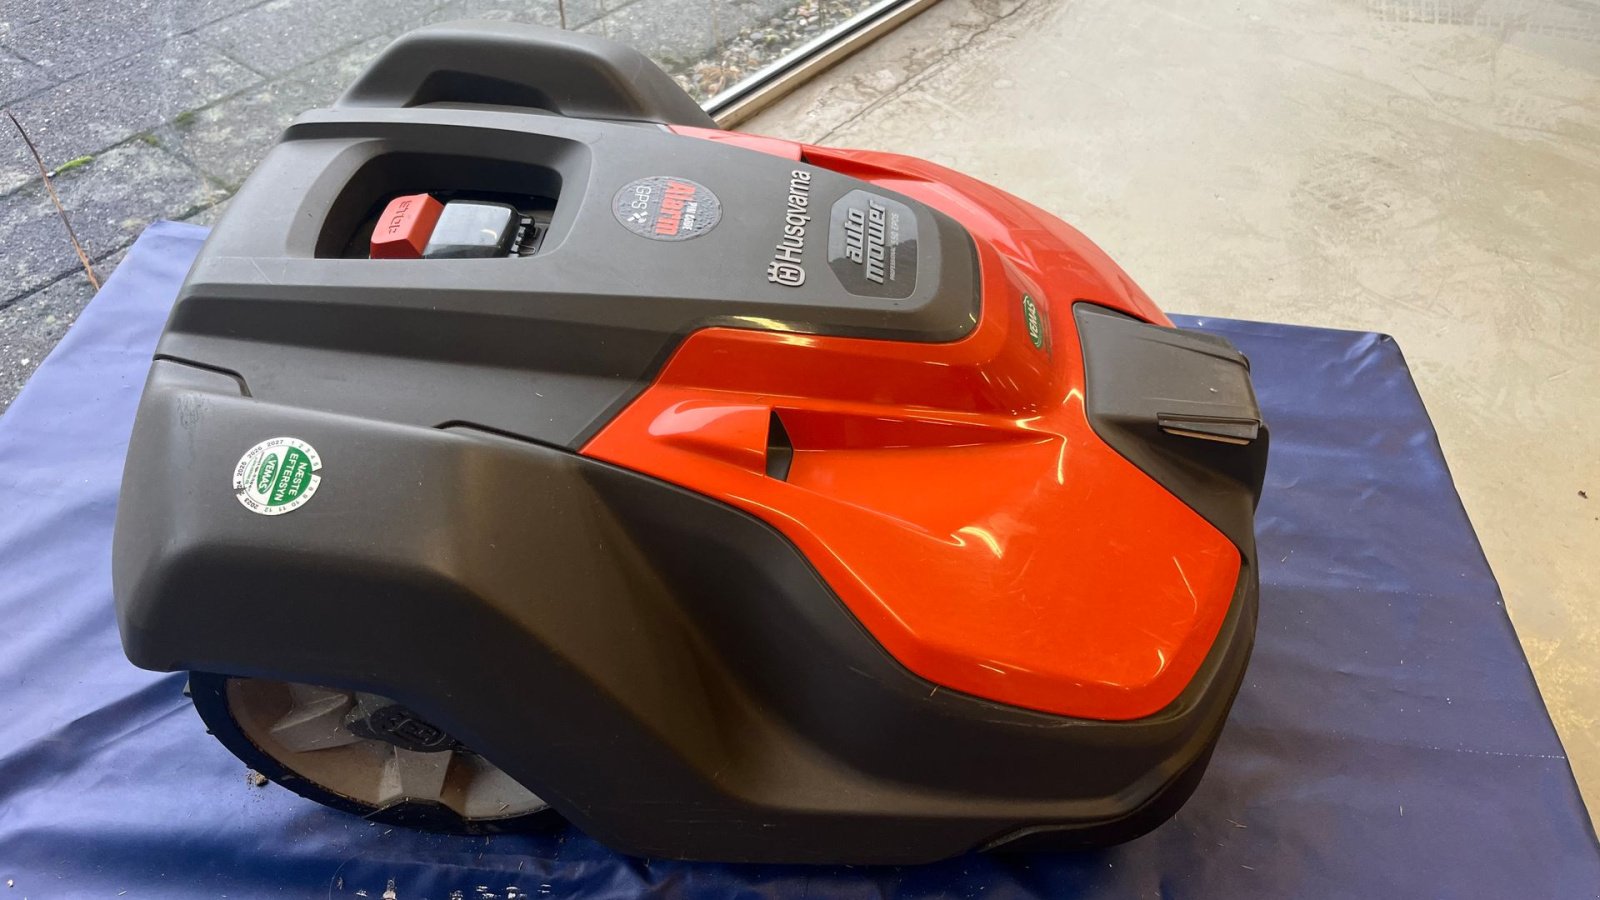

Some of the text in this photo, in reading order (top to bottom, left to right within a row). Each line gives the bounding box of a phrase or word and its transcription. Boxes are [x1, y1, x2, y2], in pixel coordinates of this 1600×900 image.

[631, 185, 652, 210] GPS
[655, 179, 697, 236] Alarm
[682, 201, 698, 231] PIN CODE
[775, 169, 811, 264] Husqvarna
[844, 207, 866, 265] auto
[866, 199, 886, 285] mower
[1027, 300, 1038, 339] VEMAS
[247, 446, 263, 459] 2026
[266, 439, 284, 447] 2027
[236, 461, 247, 477] 2025
[258, 459, 278, 490] VEMAS
[274, 453, 299, 501] EFTERSYN
[288, 462, 308, 496] NÆSTE
[243, 498, 259, 510] 2023
